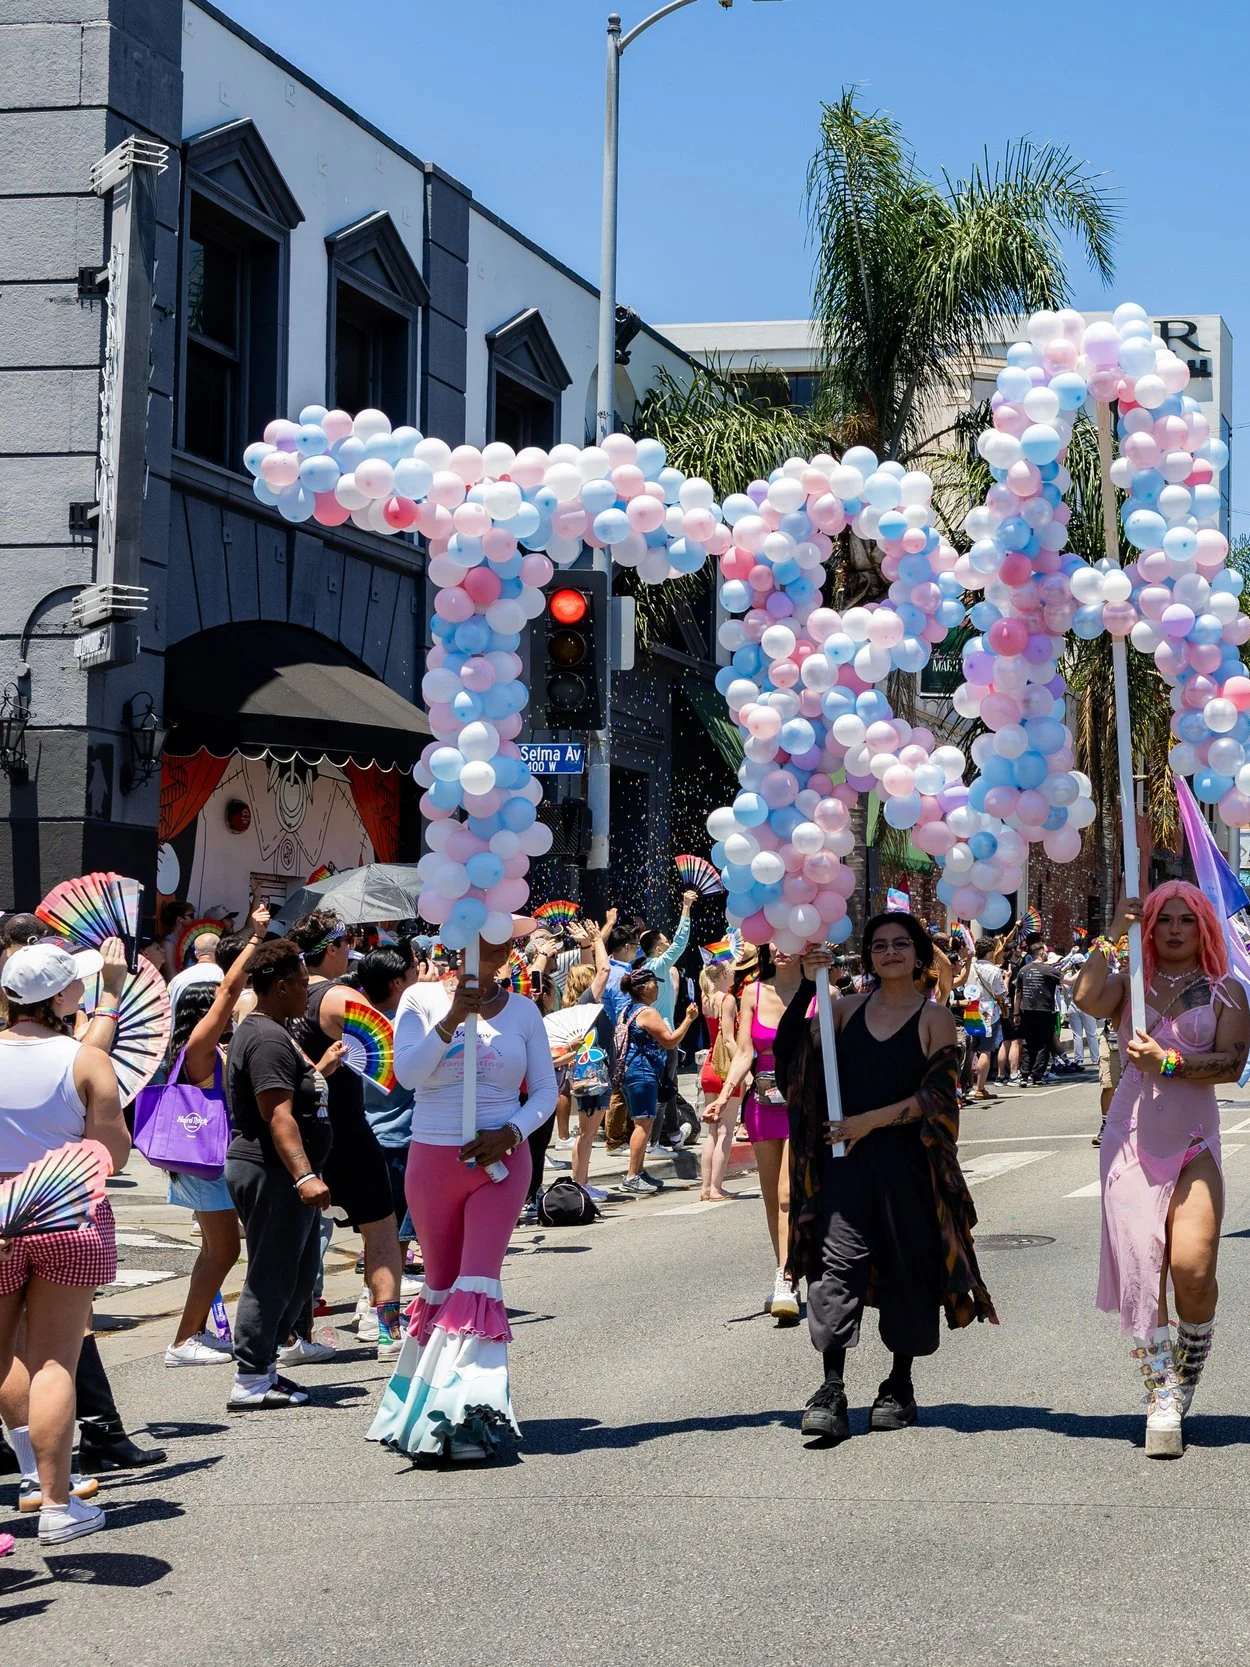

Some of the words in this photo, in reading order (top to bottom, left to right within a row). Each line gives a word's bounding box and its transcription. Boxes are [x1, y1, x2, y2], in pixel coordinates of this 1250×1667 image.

[520, 746, 560, 761] Selma
[565, 746, 581, 761] Av
[549, 761, 557, 772] W
